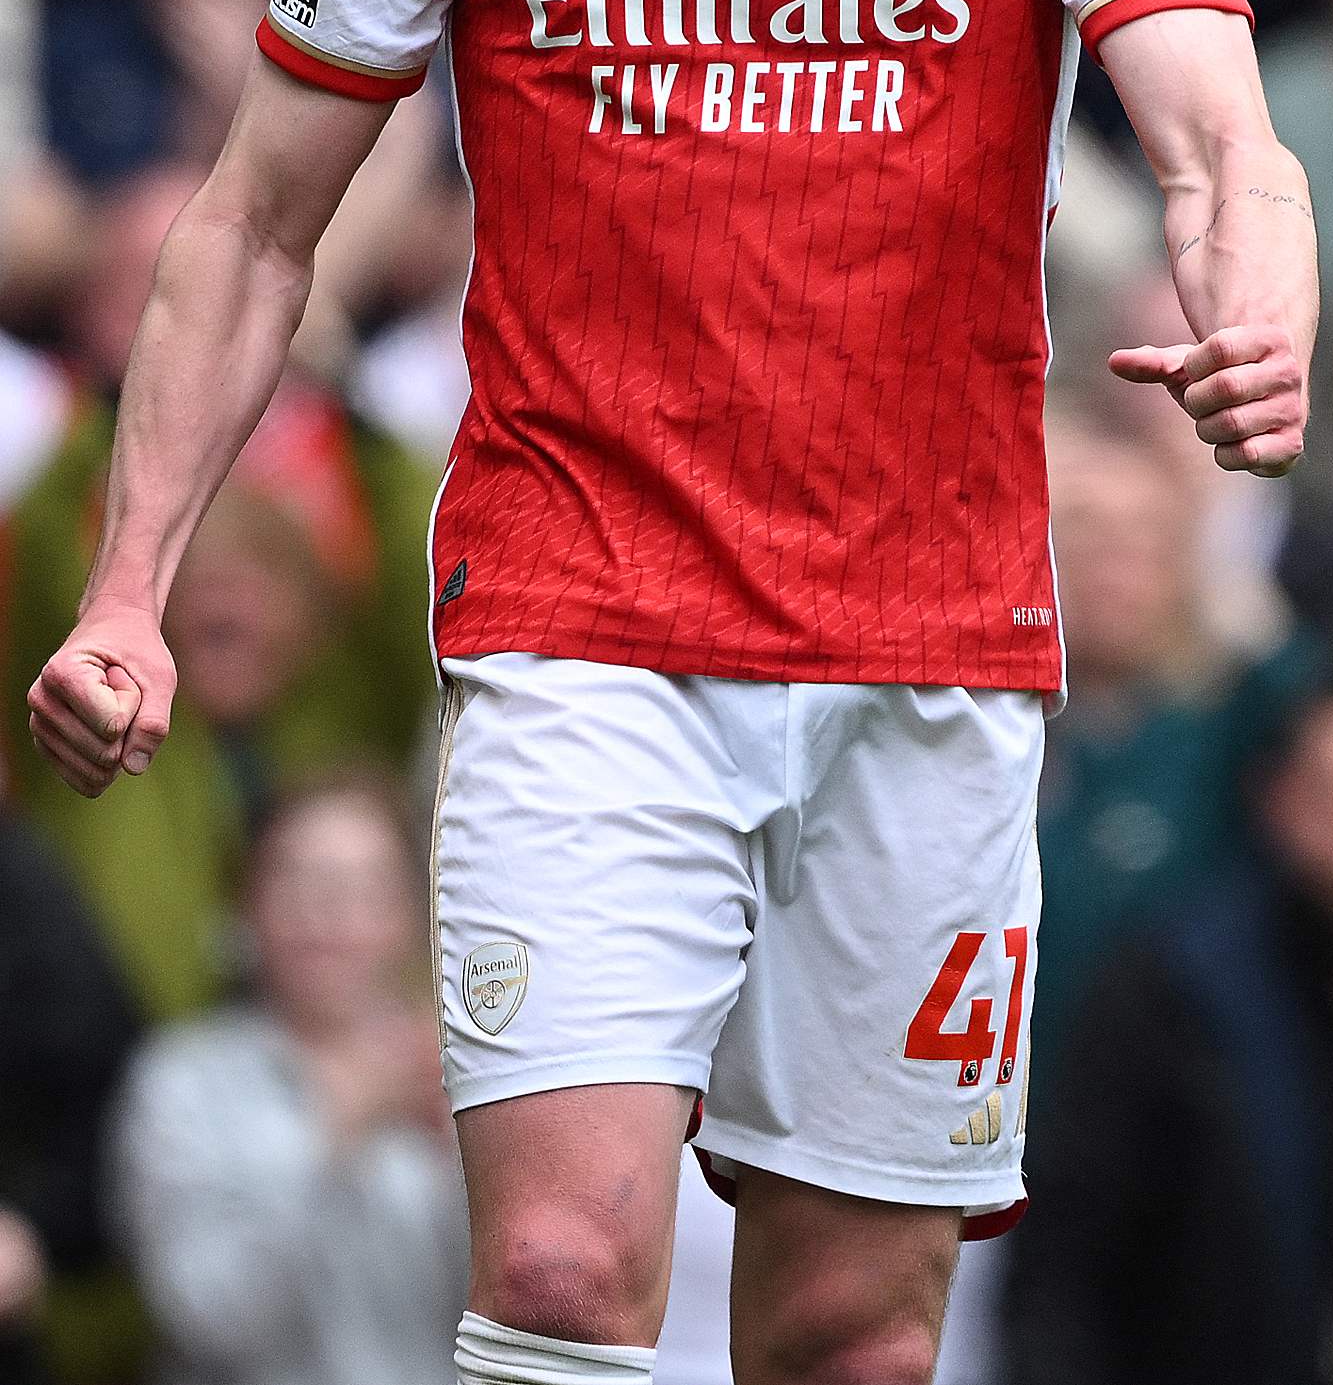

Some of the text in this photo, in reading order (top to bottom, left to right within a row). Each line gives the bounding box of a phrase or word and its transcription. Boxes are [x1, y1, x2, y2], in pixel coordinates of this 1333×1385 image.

[588, 60, 905, 134] FLY BETTER
[471, 955, 518, 978] Arsenal
[903, 925, 1028, 1087] 41
